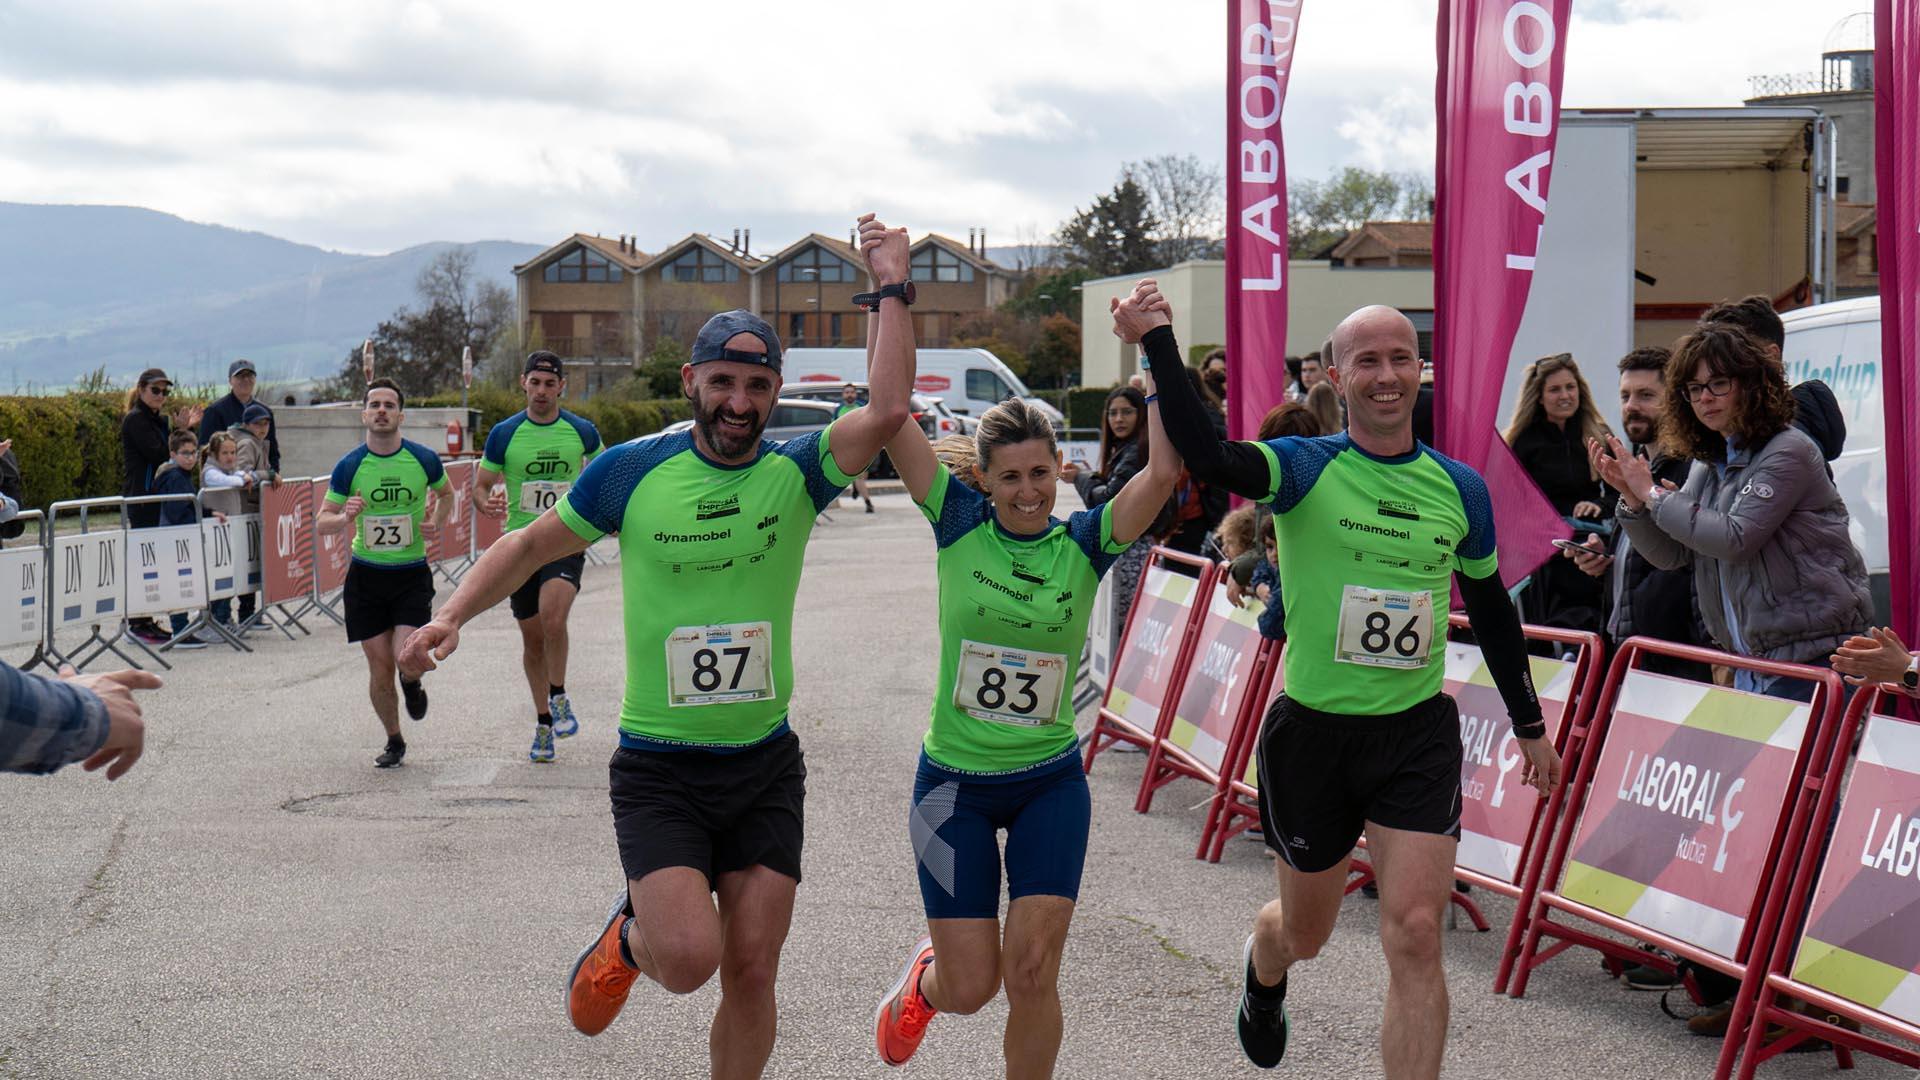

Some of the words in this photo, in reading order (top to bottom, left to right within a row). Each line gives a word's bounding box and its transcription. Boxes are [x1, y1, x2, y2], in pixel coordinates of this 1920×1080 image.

[534, 490, 557, 509] 10
[213, 523, 232, 568] DN
[373, 525, 402, 545] 23
[653, 528, 732, 544] dynamobel
[1339, 517, 1411, 540] dynamobel
[97, 539, 116, 588] DN
[140, 541, 157, 567] DN
[176, 538, 191, 563] DN
[22, 562, 36, 591] DN
[64, 544, 84, 594] DN
[972, 569, 1034, 603] dynamobel
[1360, 611, 1420, 657] 86
[692, 646, 751, 692] 87
[976, 667, 1042, 714] 83
[1617, 749, 1721, 825] LABORAL
[1675, 833, 1707, 865] kutxa
[1860, 807, 1920, 881] LAB
